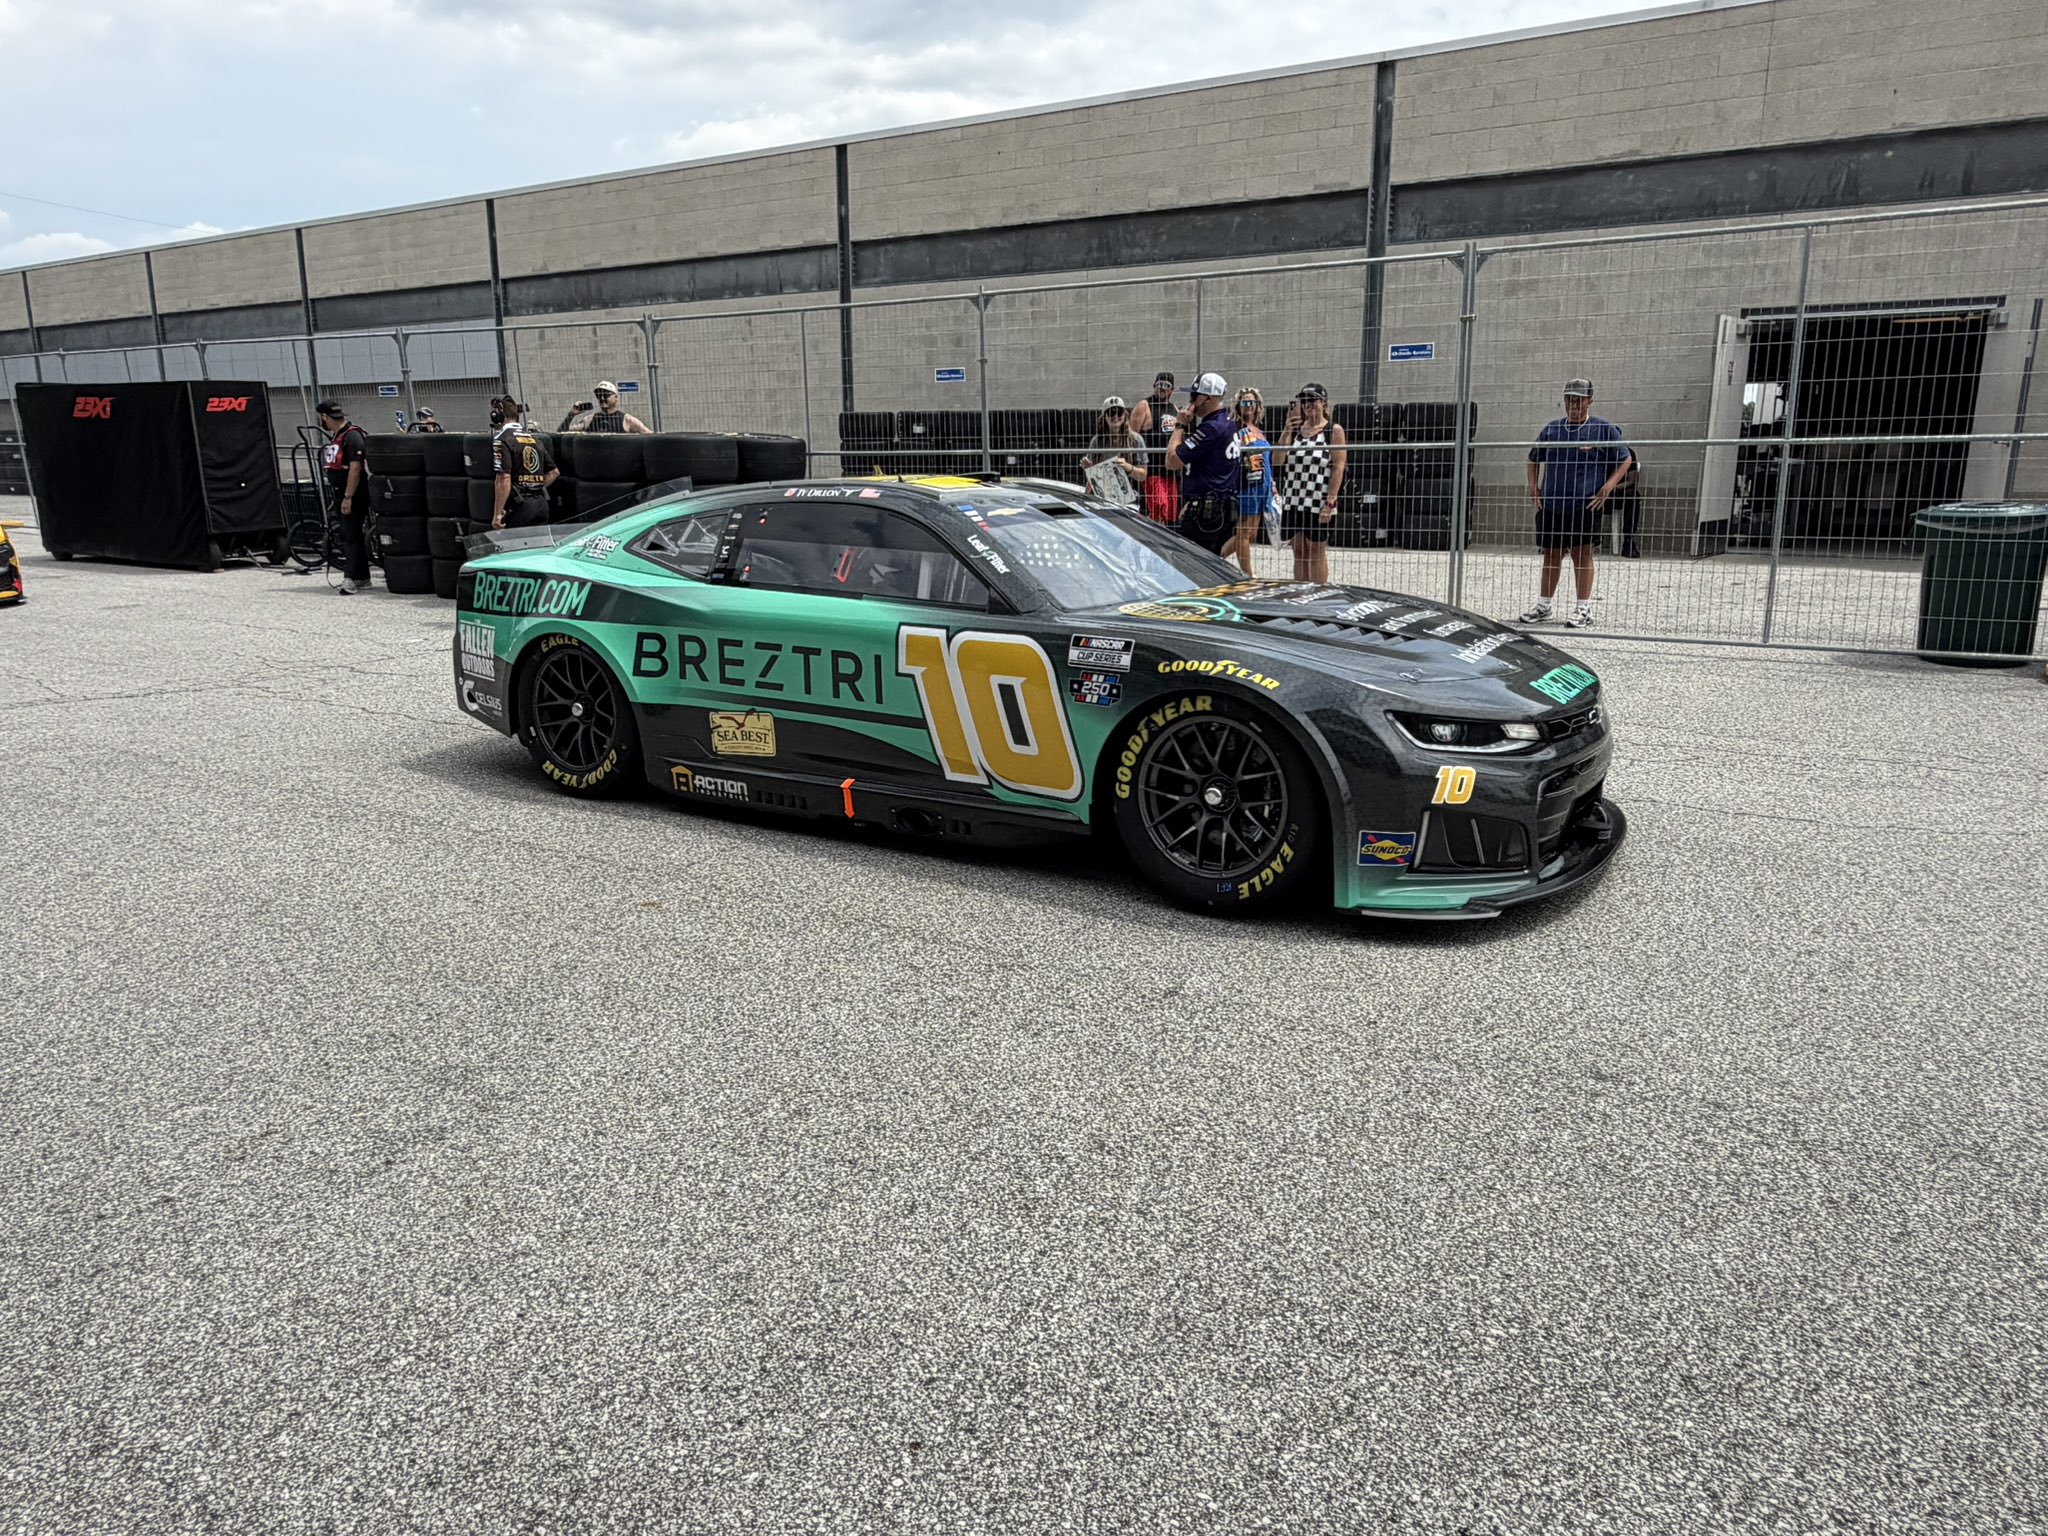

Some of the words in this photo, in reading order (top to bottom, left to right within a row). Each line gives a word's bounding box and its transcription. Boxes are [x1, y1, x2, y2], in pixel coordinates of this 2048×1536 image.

[473, 571, 592, 616] BREZTRI.COM
[460, 623, 495, 659] FALLEN
[540, 634, 579, 653] EAGLE
[1080, 638, 1125, 650] NASCAR
[461, 652, 495, 678] OUTDOORS
[632, 631, 884, 705] BREZTRI
[1077, 651, 1094, 661] CUP
[1093, 652, 1123, 664] SERIES
[1080, 681, 1111, 696] 250
[1157, 659, 1281, 691] GOODYEAR
[475, 691, 502, 710] CELSIUS
[898, 625, 1083, 800] 10
[717, 730, 739, 742] SEA
[741, 730, 770, 744] BEST
[1115, 695, 1213, 799] GOODYEAR
[542, 749, 617, 789] GOODYEAR
[694, 774, 748, 796] ACTION
[1431, 766, 1476, 804] 10
[1363, 845, 1409, 855] SUNOCO
[1238, 841, 1295, 900] EAGLE
